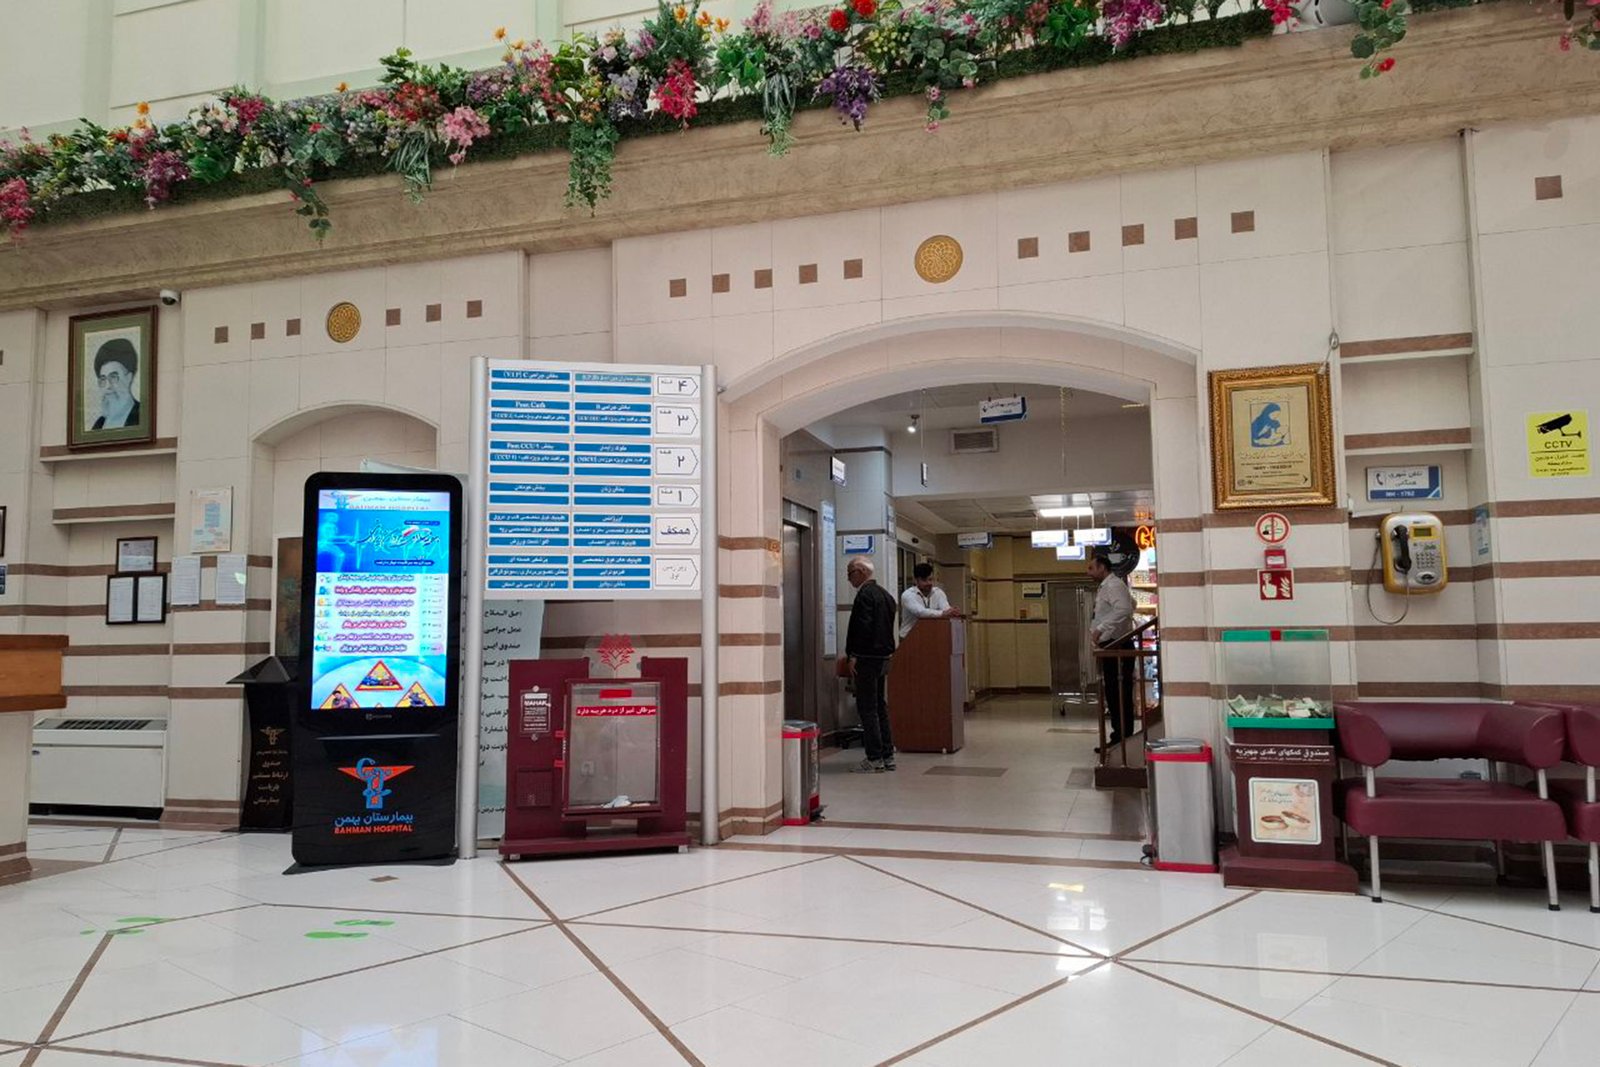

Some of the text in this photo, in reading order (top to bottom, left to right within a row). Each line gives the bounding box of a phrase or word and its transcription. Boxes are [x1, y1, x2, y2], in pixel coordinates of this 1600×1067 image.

[677, 380, 688, 392] ۴
[676, 414, 689, 427] ۳
[1544, 440, 1573, 449] CCTV
[676, 455, 686, 468] ۲
[660, 525, 691, 536] همکف
[1303, 749, 1330, 758] صندوق
[333, 811, 414, 828] بیمارستان بهمن
[334, 824, 413, 835] BAHMAN HOSPITAL
